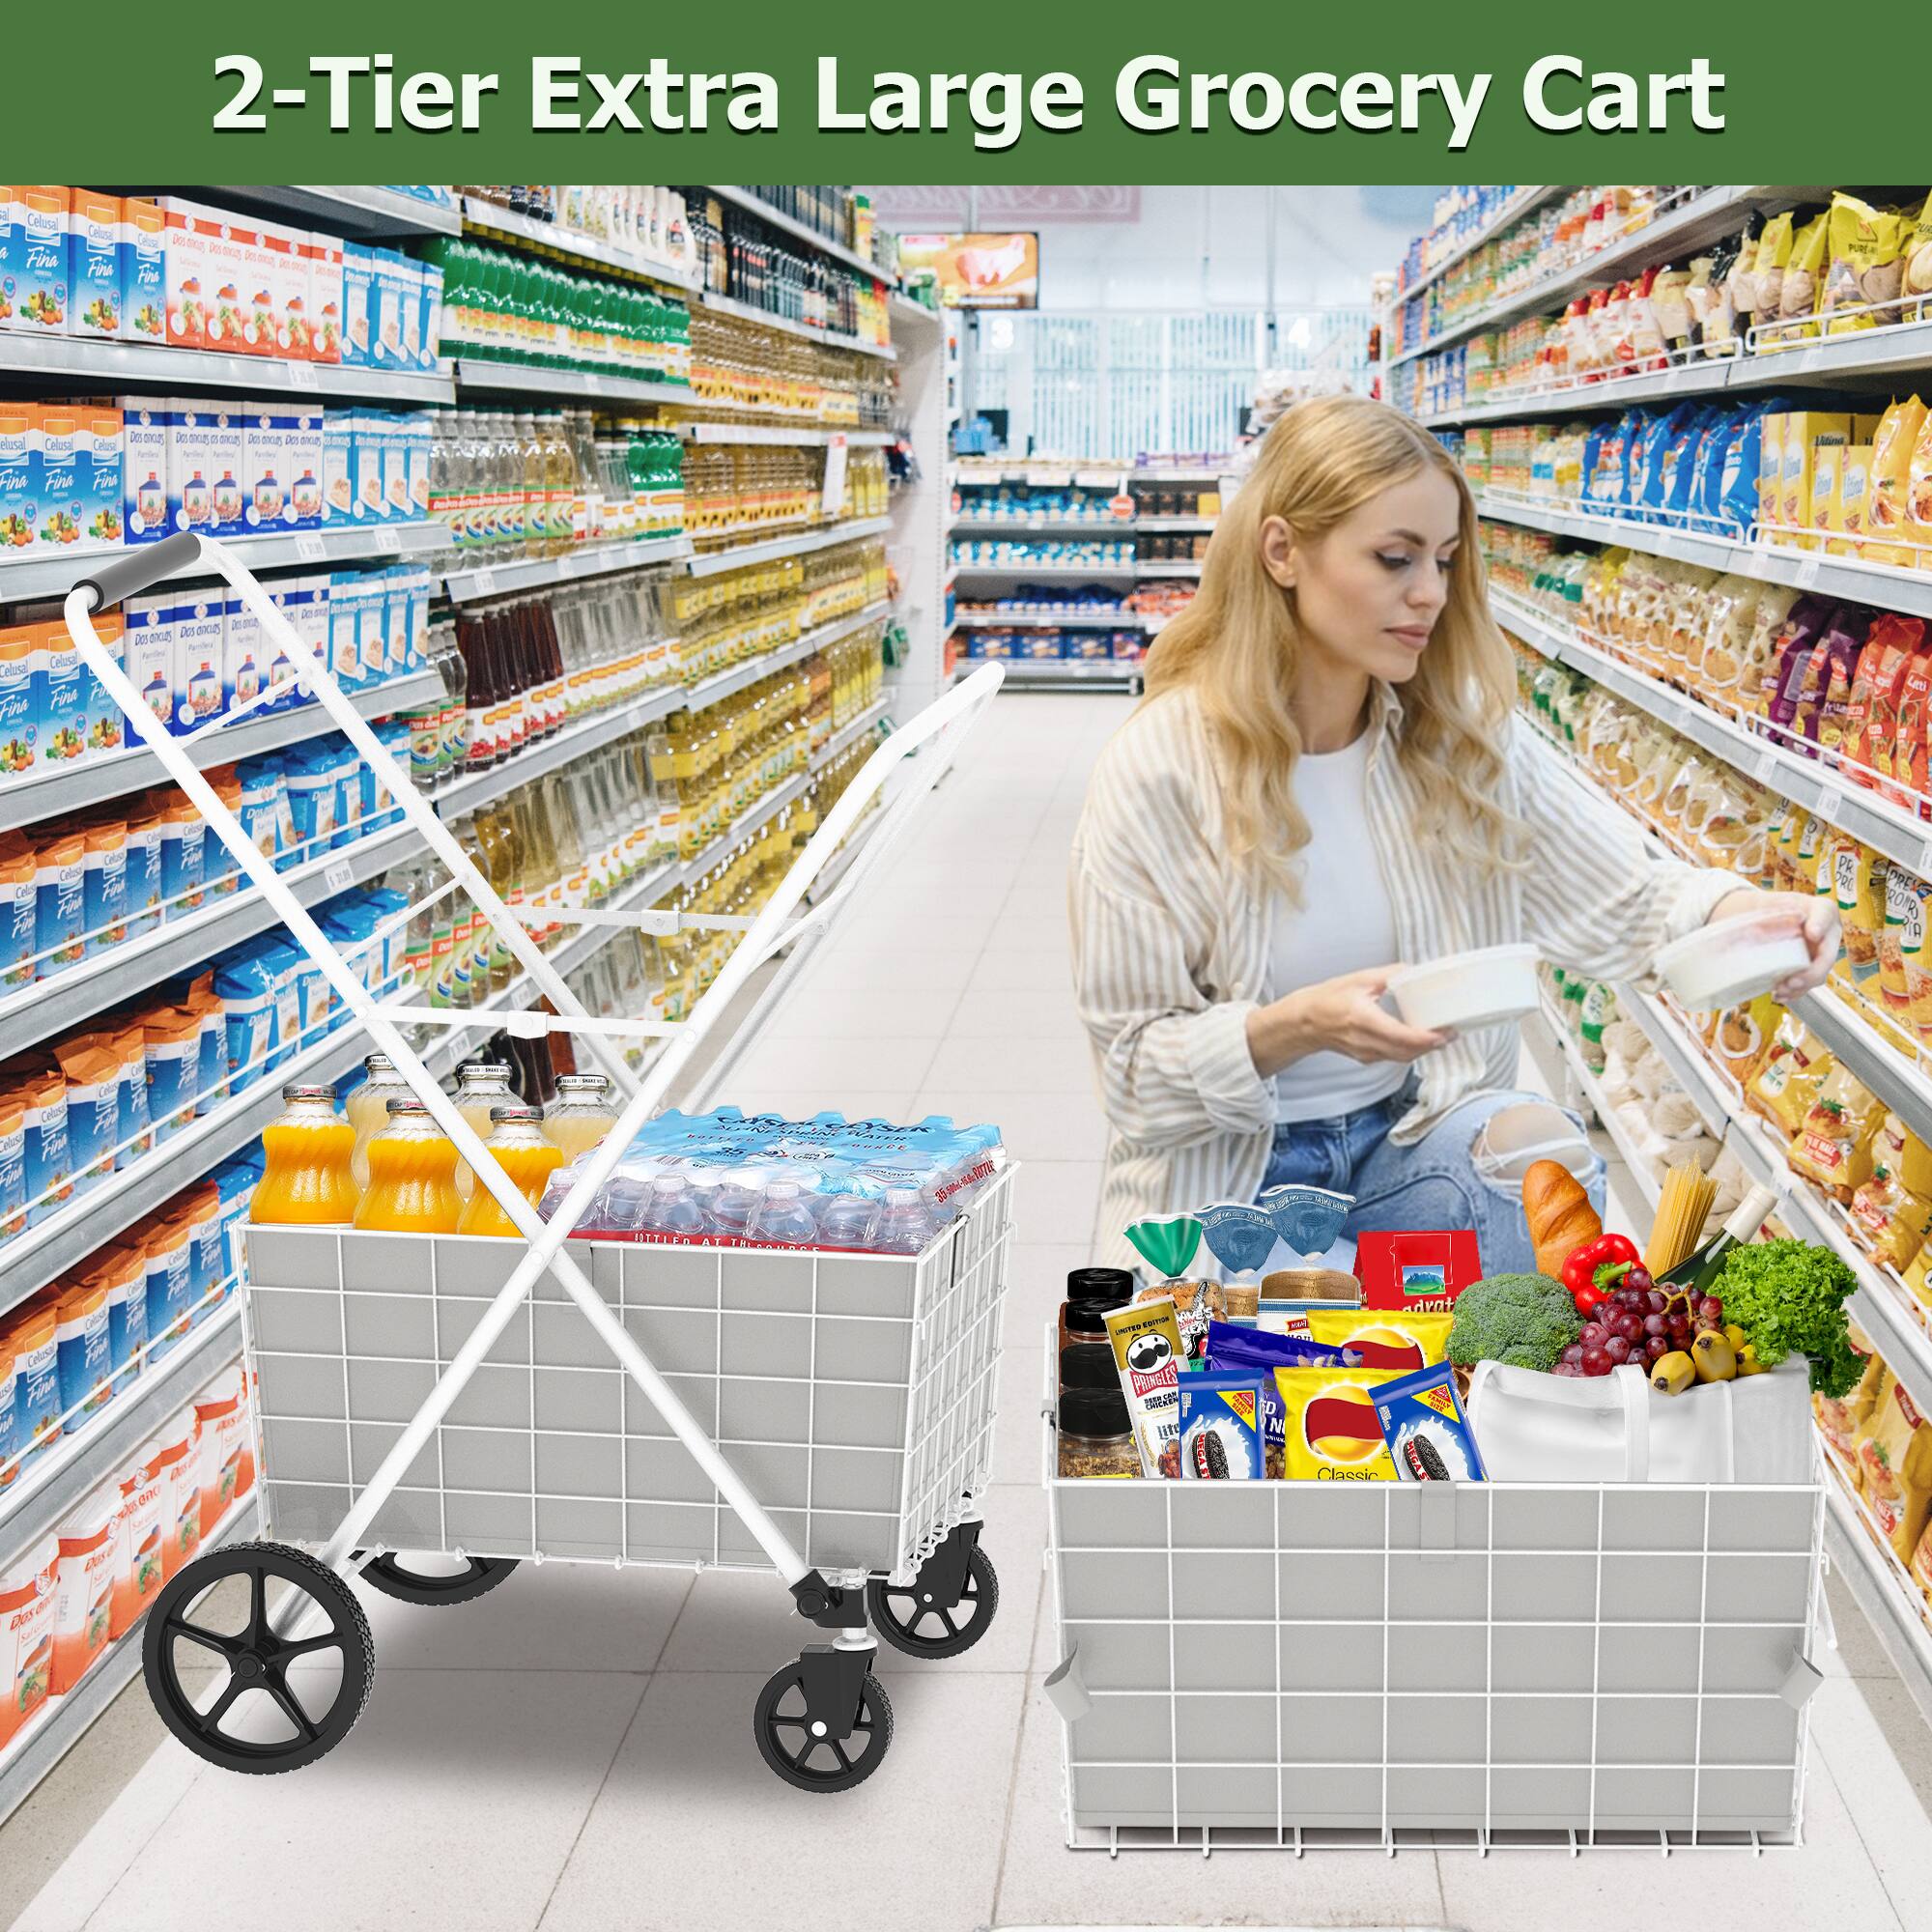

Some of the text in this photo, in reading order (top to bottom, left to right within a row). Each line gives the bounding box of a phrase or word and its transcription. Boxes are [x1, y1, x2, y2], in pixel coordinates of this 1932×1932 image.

[27, 213, 59, 231] Celusal
[26, 246, 59, 269] Fina
[88, 256, 114, 278] Fina
[0, 438, 26, 451] elusal
[44, 438, 73, 451] Celusal
[45, 469, 74, 492] Fina
[93, 468, 118, 491] Fina
[50, 651, 78, 668] Celusal
[50, 684, 78, 710] Fina
[1143, 1316, 1170, 1329] EDITION
[1133, 1364, 1178, 1394] PRINGLES
[27, 1376, 55, 1407] Fina
[1144, 1391, 1177, 1405] BEER CAN
[1146, 1398, 1179, 1410] CHICKEN
[1232, 1394, 1252, 1415] FAMILY
[1232, 1403, 1244, 1416] SIZE
[1428, 1393, 1451, 1409] FAMILY
[1430, 1402, 1444, 1412] SIZE
[1197, 1433, 1207, 1466] MEGA
[1407, 1440, 1424, 1472] MEGA
[1318, 1467, 1378, 1480] Classic
